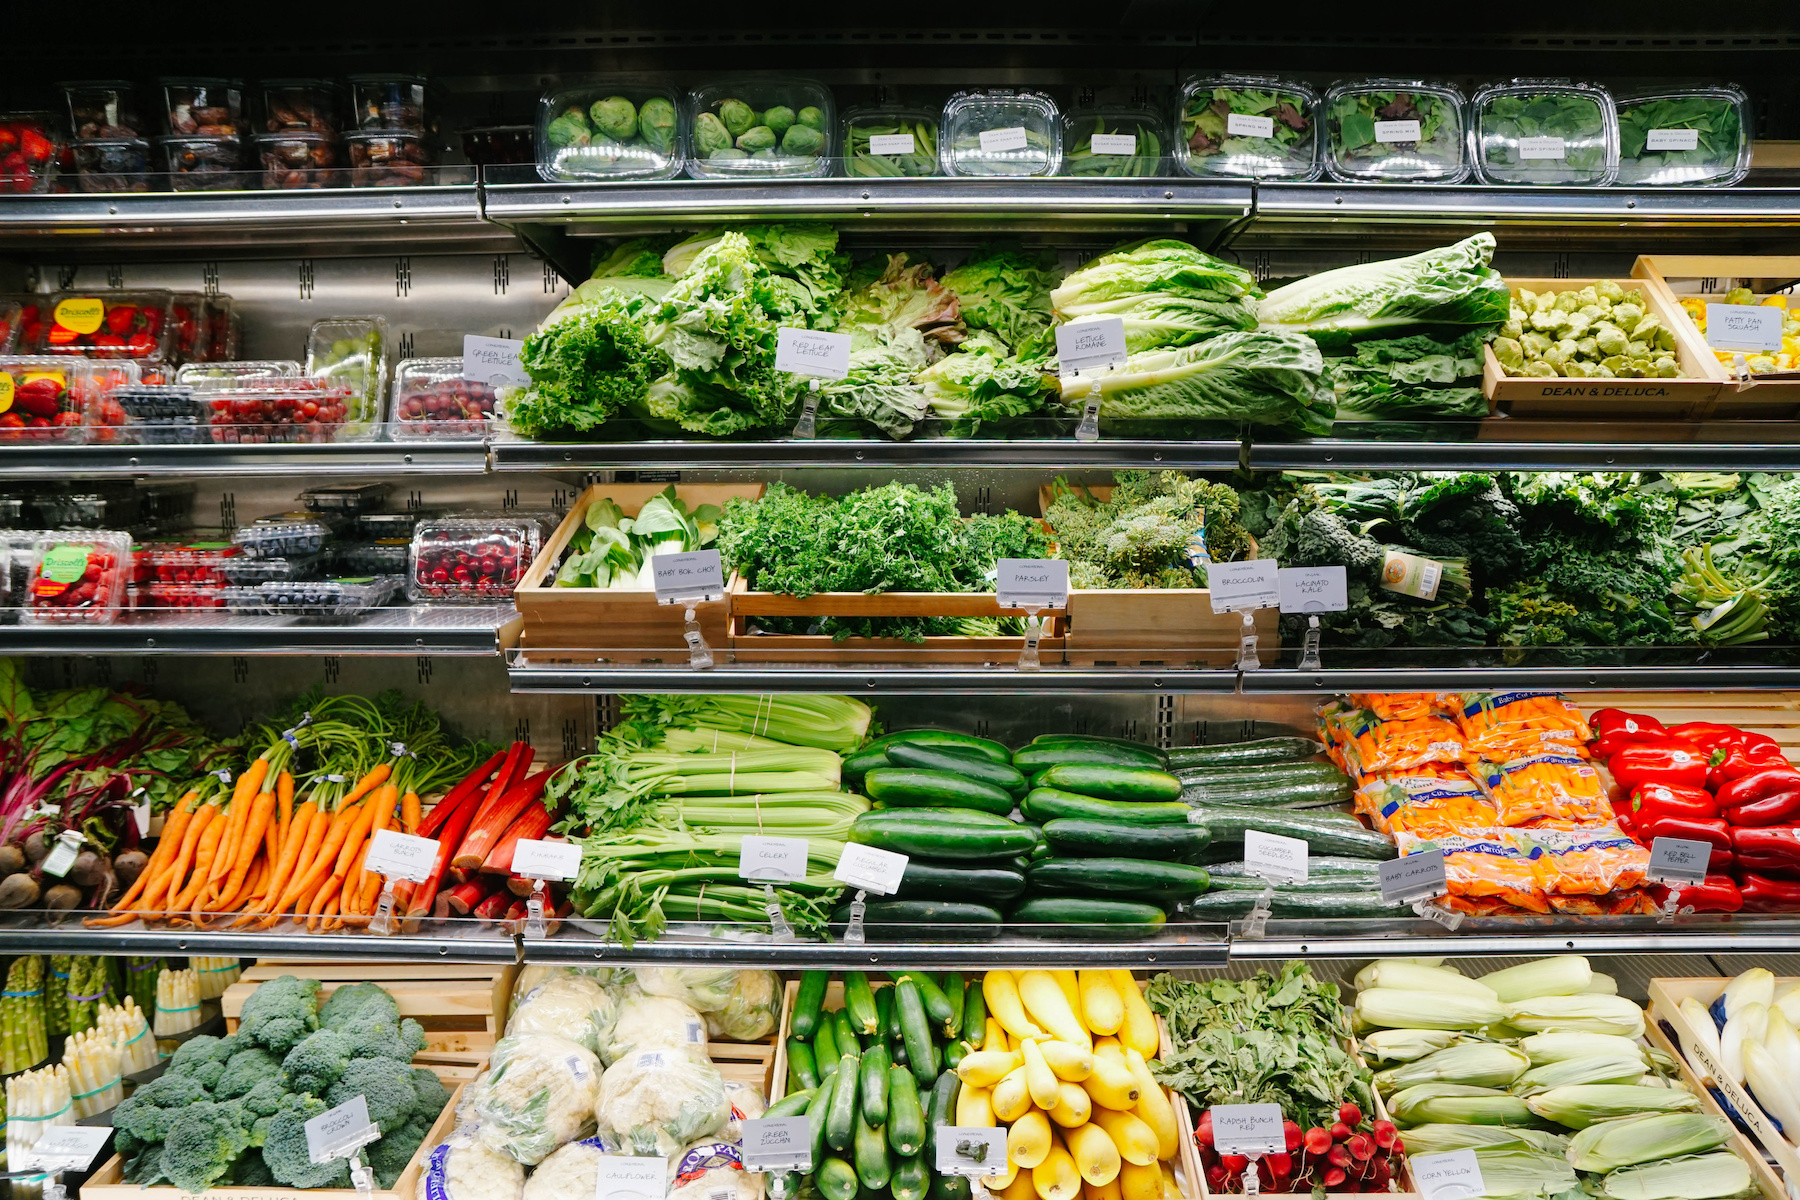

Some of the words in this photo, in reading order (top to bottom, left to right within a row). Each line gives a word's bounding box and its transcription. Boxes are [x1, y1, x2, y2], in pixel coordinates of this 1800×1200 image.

[60, 307, 101, 317] Driscoll's
[1724, 316, 1745, 324] PATTY
[1747, 317, 1762, 325] PAN
[1727, 323, 1760, 332] SQUASH
[1075, 334, 1105, 345] LETTUCE
[792, 339, 810, 350] RED
[812, 342, 835, 352] LEAF
[472, 348, 499, 358] GREEN
[501, 352, 519, 360] LEA
[796, 348, 829, 358] LETTUCE
[481, 356, 513, 366] LETTUCE
[1541, 387, 1586, 396] DEAN
[1588, 387, 1599, 396] &
[45, 557, 85, 567] Driscoll's
[657, 568, 676, 577] BABY
[678, 567, 694, 576] BOK
[696, 564, 716, 573] CHOY
[1014, 574, 1049, 583] PARSLEY
[1221, 576, 1265, 586] BROCCOLINI
[1295, 579, 1329, 588] LACINATO
[1301, 586, 1323, 594] KALE
[1498, 696, 1515, 704] Baby
[390, 840, 423, 854] CARROTS
[1257, 843, 1294, 855] CUCUMBER
[393, 847, 416, 859] BUNCH
[530, 850, 565, 860] RHUBARB
[759, 850, 789, 860] CELERY
[1257, 849, 1294, 862] SEEDLESS
[1679, 851, 1697, 859] BELL
[855, 856, 889, 868] REGULAR
[1666, 856, 1690, 864] PEPPER
[852, 861, 888, 874] CUCUMBER
[1385, 871, 1403, 882] BABY
[1404, 864, 1439, 878] CARROTS
[1693, 1043, 1717, 1076] DEAN
[1717, 1074, 1723, 1084] &
[320, 1112, 354, 1132] BROCCOLI
[1219, 1117, 1247, 1126] RADISH
[1249, 1116, 1274, 1125] BUNCH
[326, 1121, 351, 1136] CROWN
[1239, 1124, 1256, 1132] RED
[762, 1130, 789, 1140] GREEN
[1421, 1171, 1442, 1181] CORN
[1442, 1166, 1473, 1177] YELLOW
